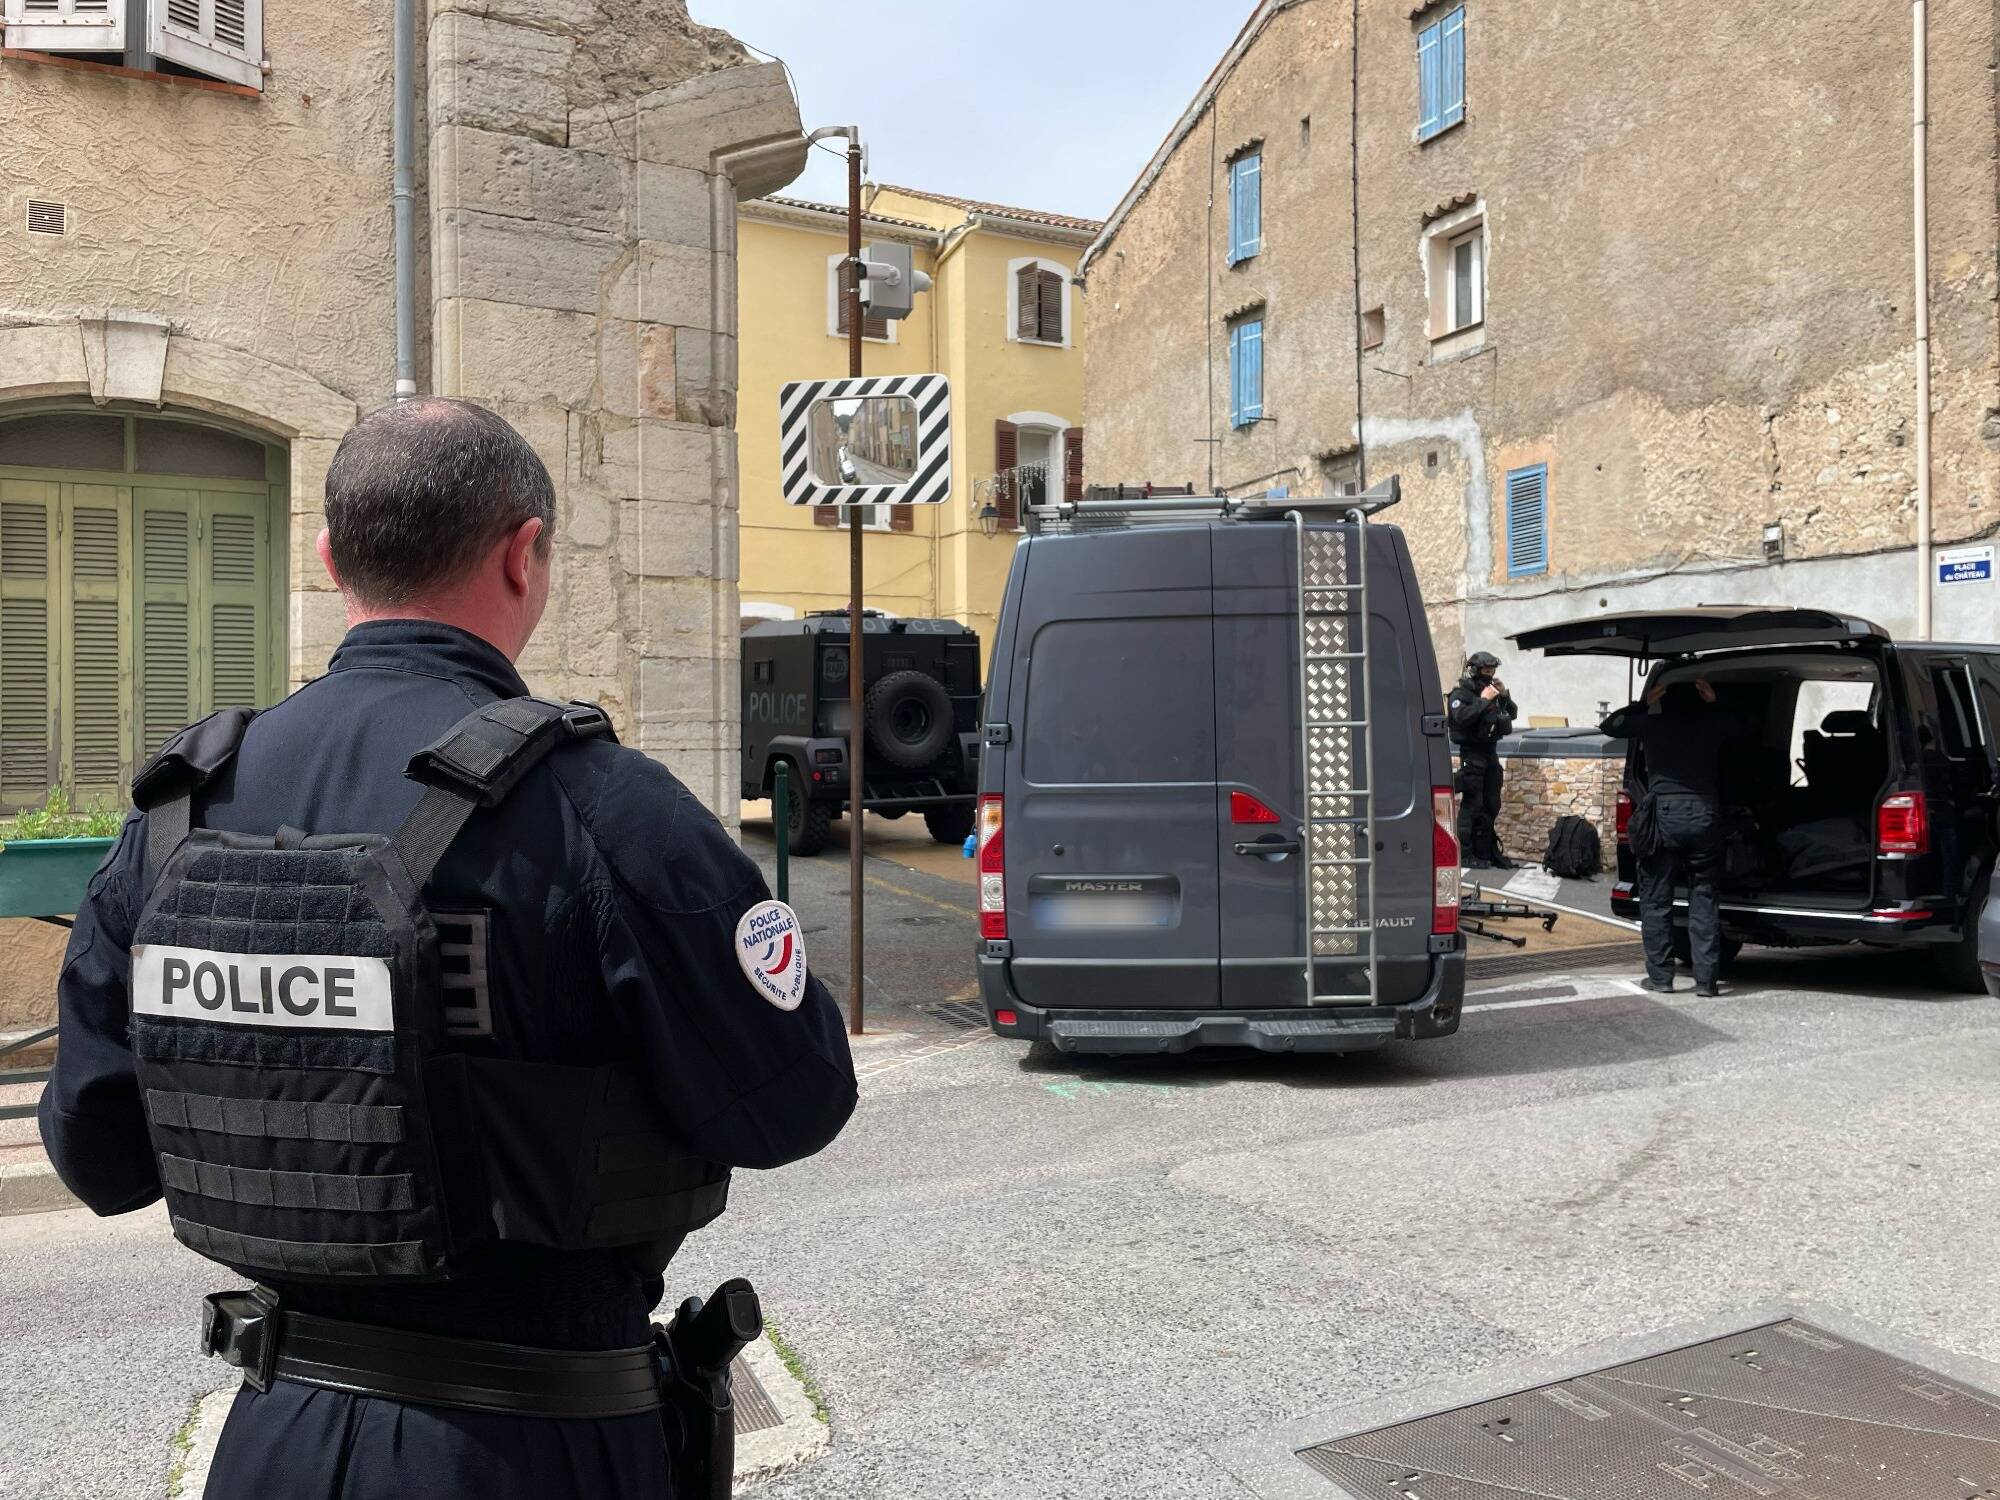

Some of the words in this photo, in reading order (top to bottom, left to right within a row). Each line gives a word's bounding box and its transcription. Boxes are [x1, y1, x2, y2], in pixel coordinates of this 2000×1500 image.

[1954, 563, 1976, 571] PLACE
[750, 692, 806, 723] POLICE
[1065, 881, 1143, 891] MASTER
[743, 918, 793, 948] NATIONALE
[750, 909, 780, 931] POLICE
[162, 959, 357, 1016] POLICE
[754, 967, 787, 1000] SECURITE
[791, 949, 802, 997] PUBLIQUE
